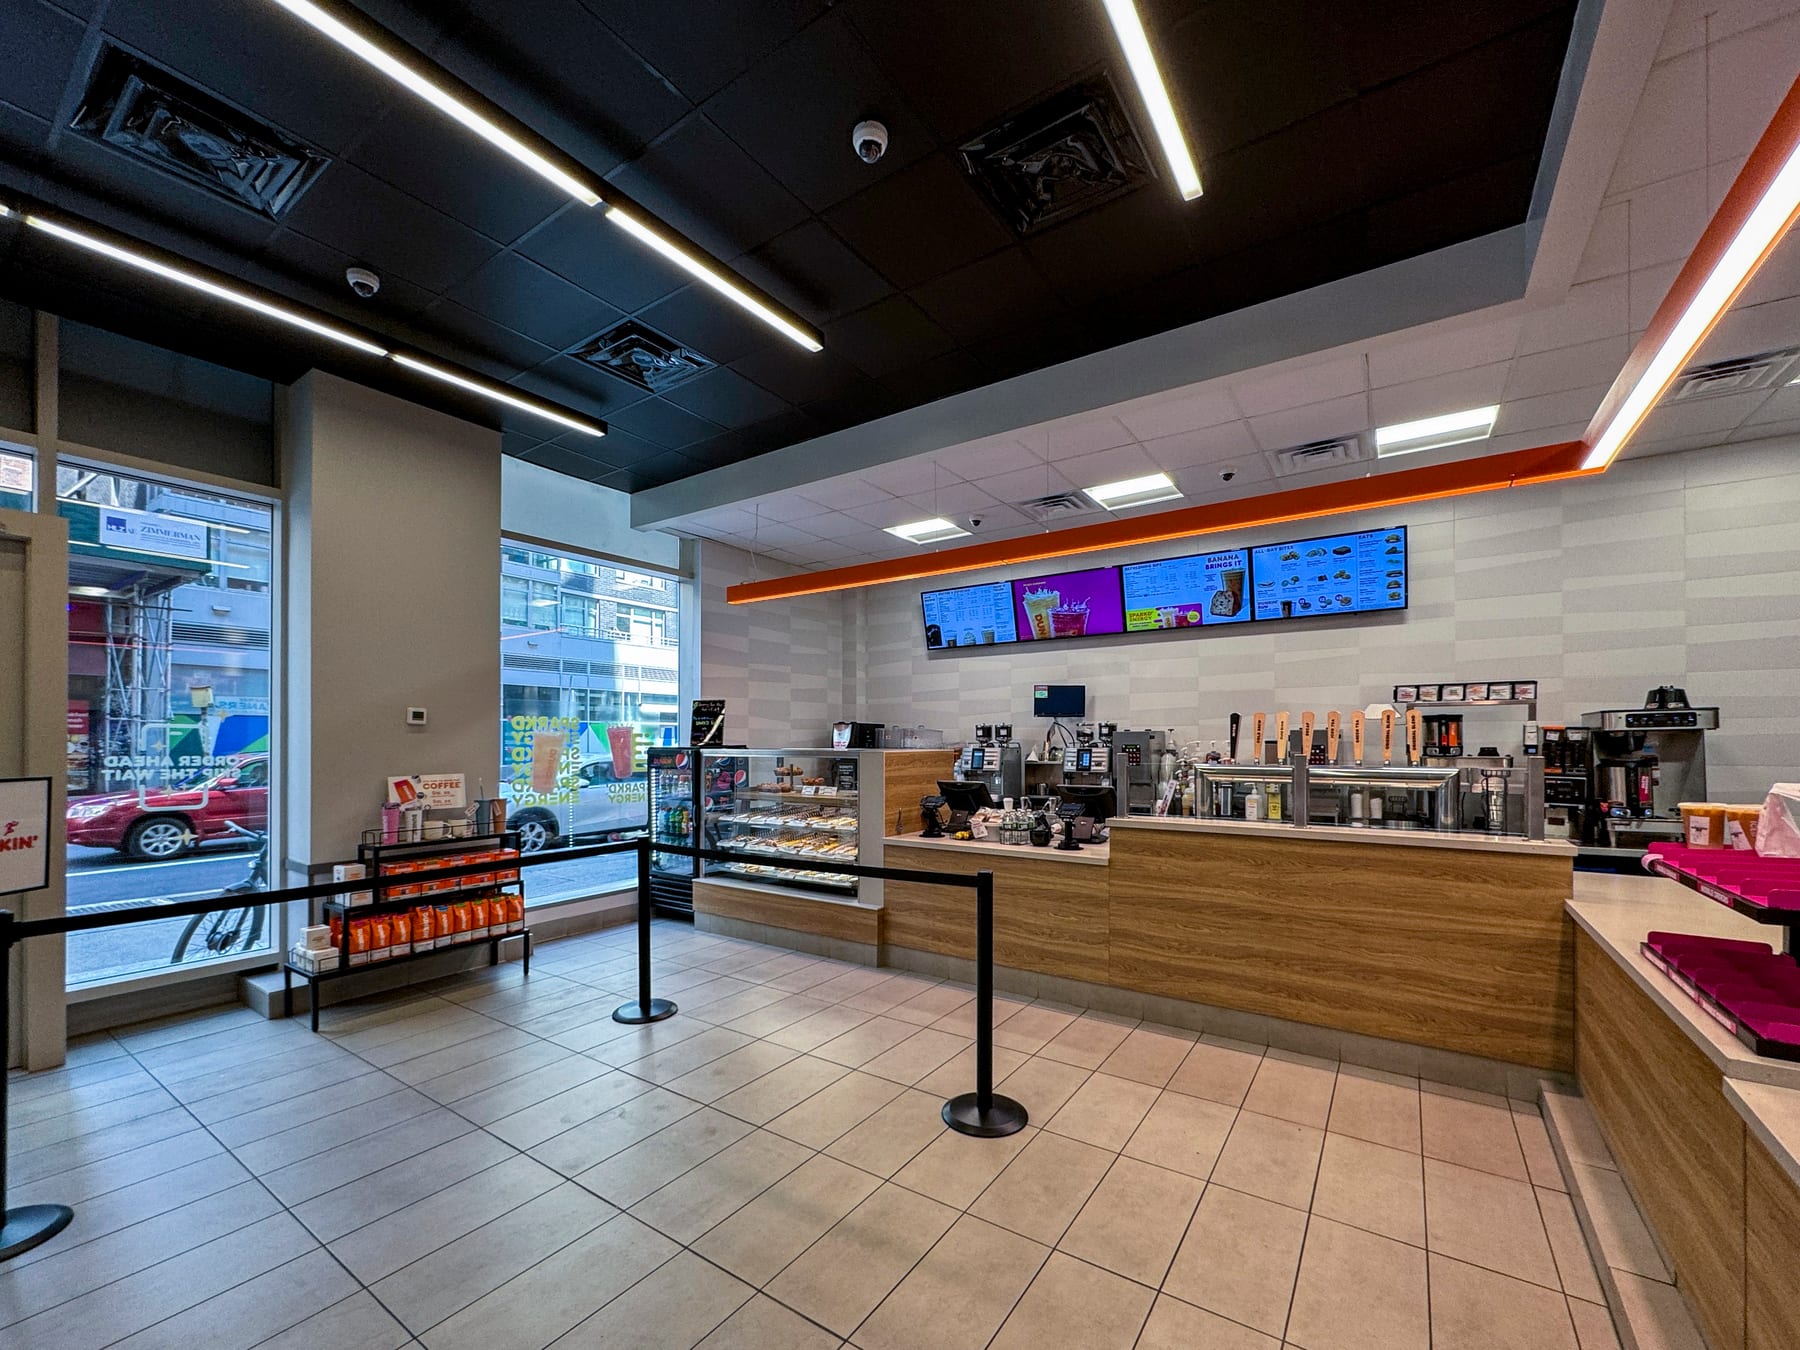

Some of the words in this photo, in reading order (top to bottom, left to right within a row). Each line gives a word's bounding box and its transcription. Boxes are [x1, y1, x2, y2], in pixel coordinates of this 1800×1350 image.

[140, 525, 201, 541] ZIMMERMAN
[1207, 554, 1240, 564] BANANA
[1205, 561, 1232, 571] BRINGS
[422, 781, 462, 790] COFFEE
